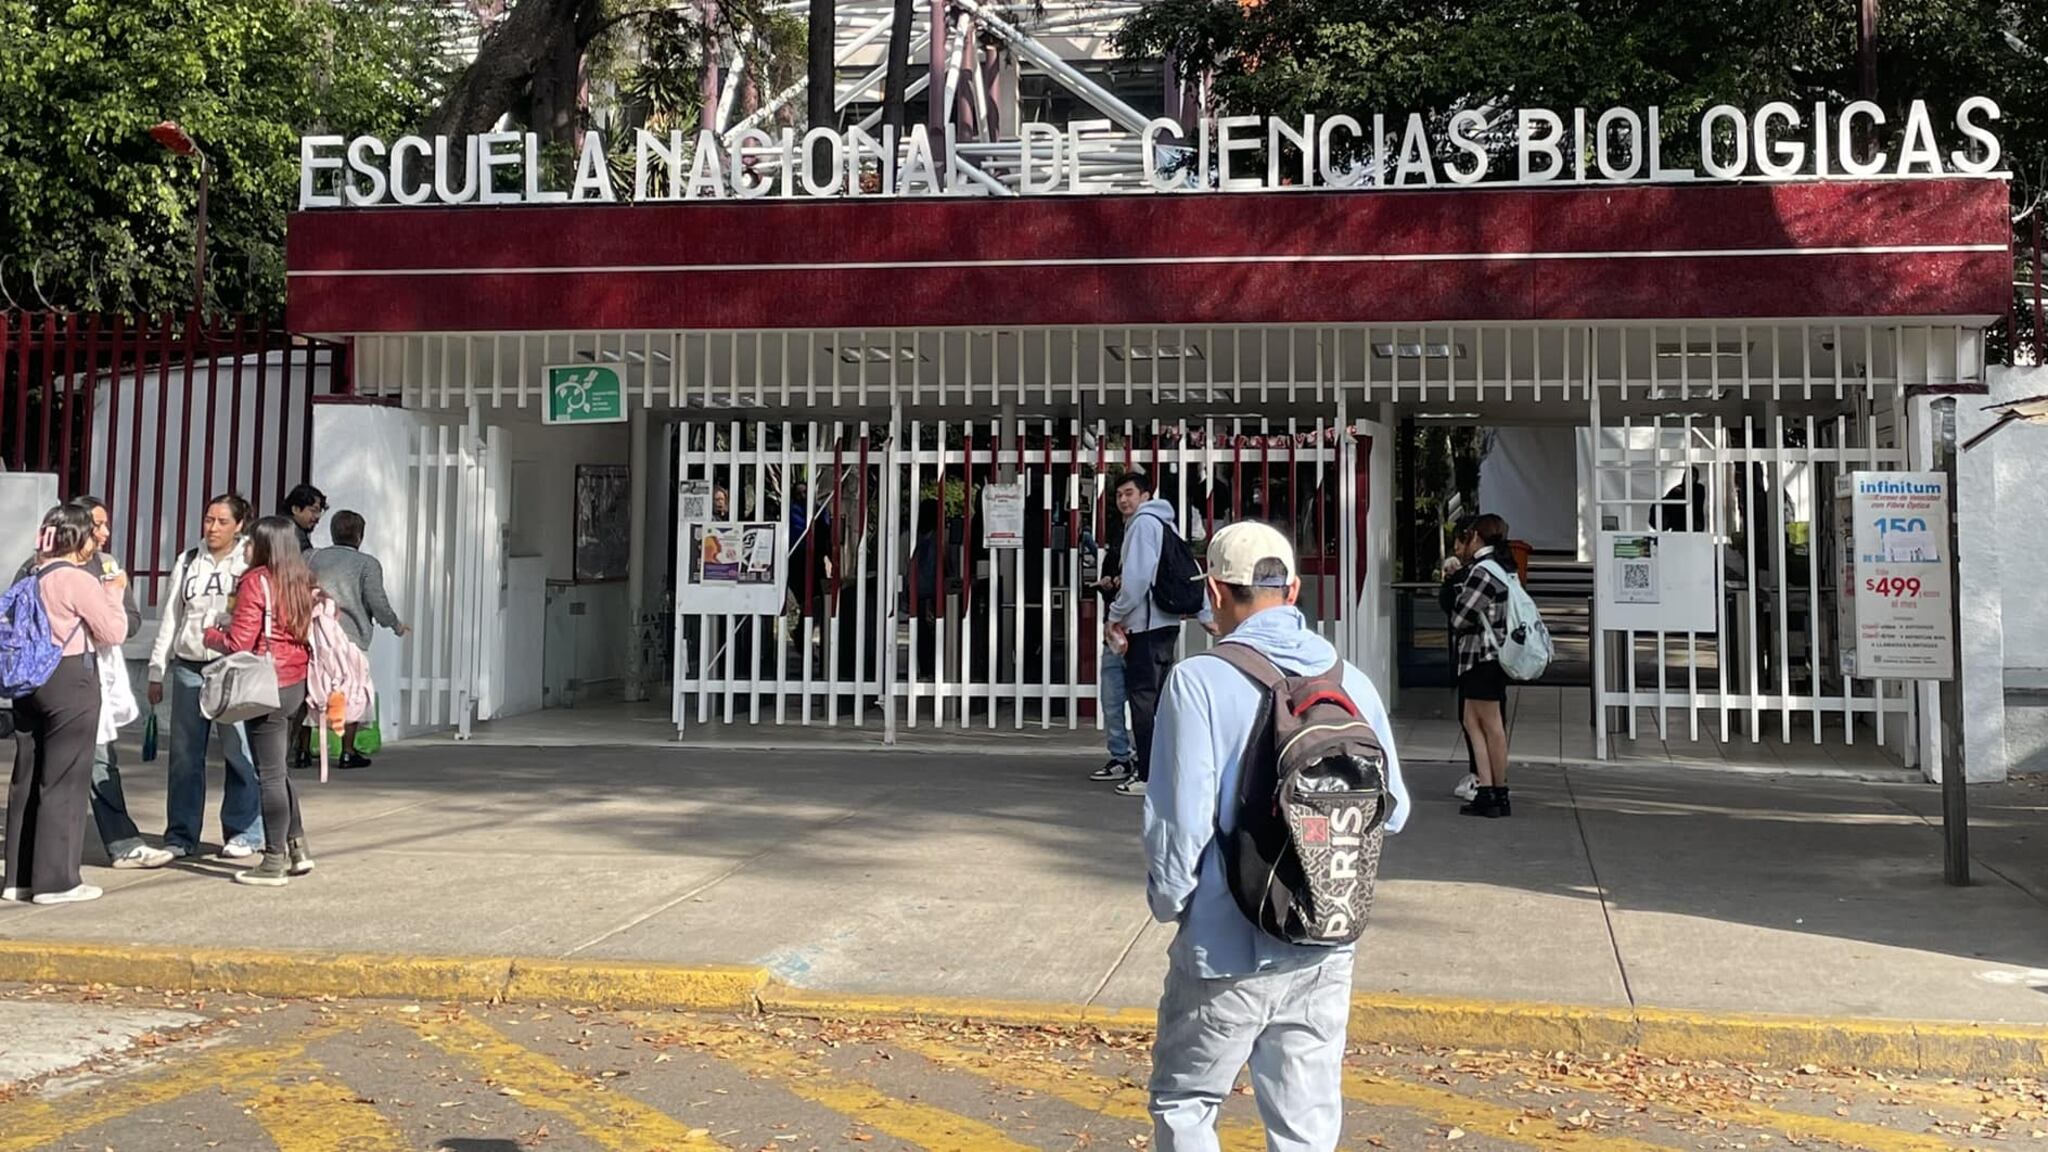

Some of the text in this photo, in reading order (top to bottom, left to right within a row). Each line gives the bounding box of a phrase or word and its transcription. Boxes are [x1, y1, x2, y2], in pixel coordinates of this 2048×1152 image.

[300, 96, 2001, 205] ESCUELA NACIONAL DE CIENCIAS BIOLOGICAS
[1860, 480, 1942, 494] infinitum
[1866, 577, 1921, 598] $499
